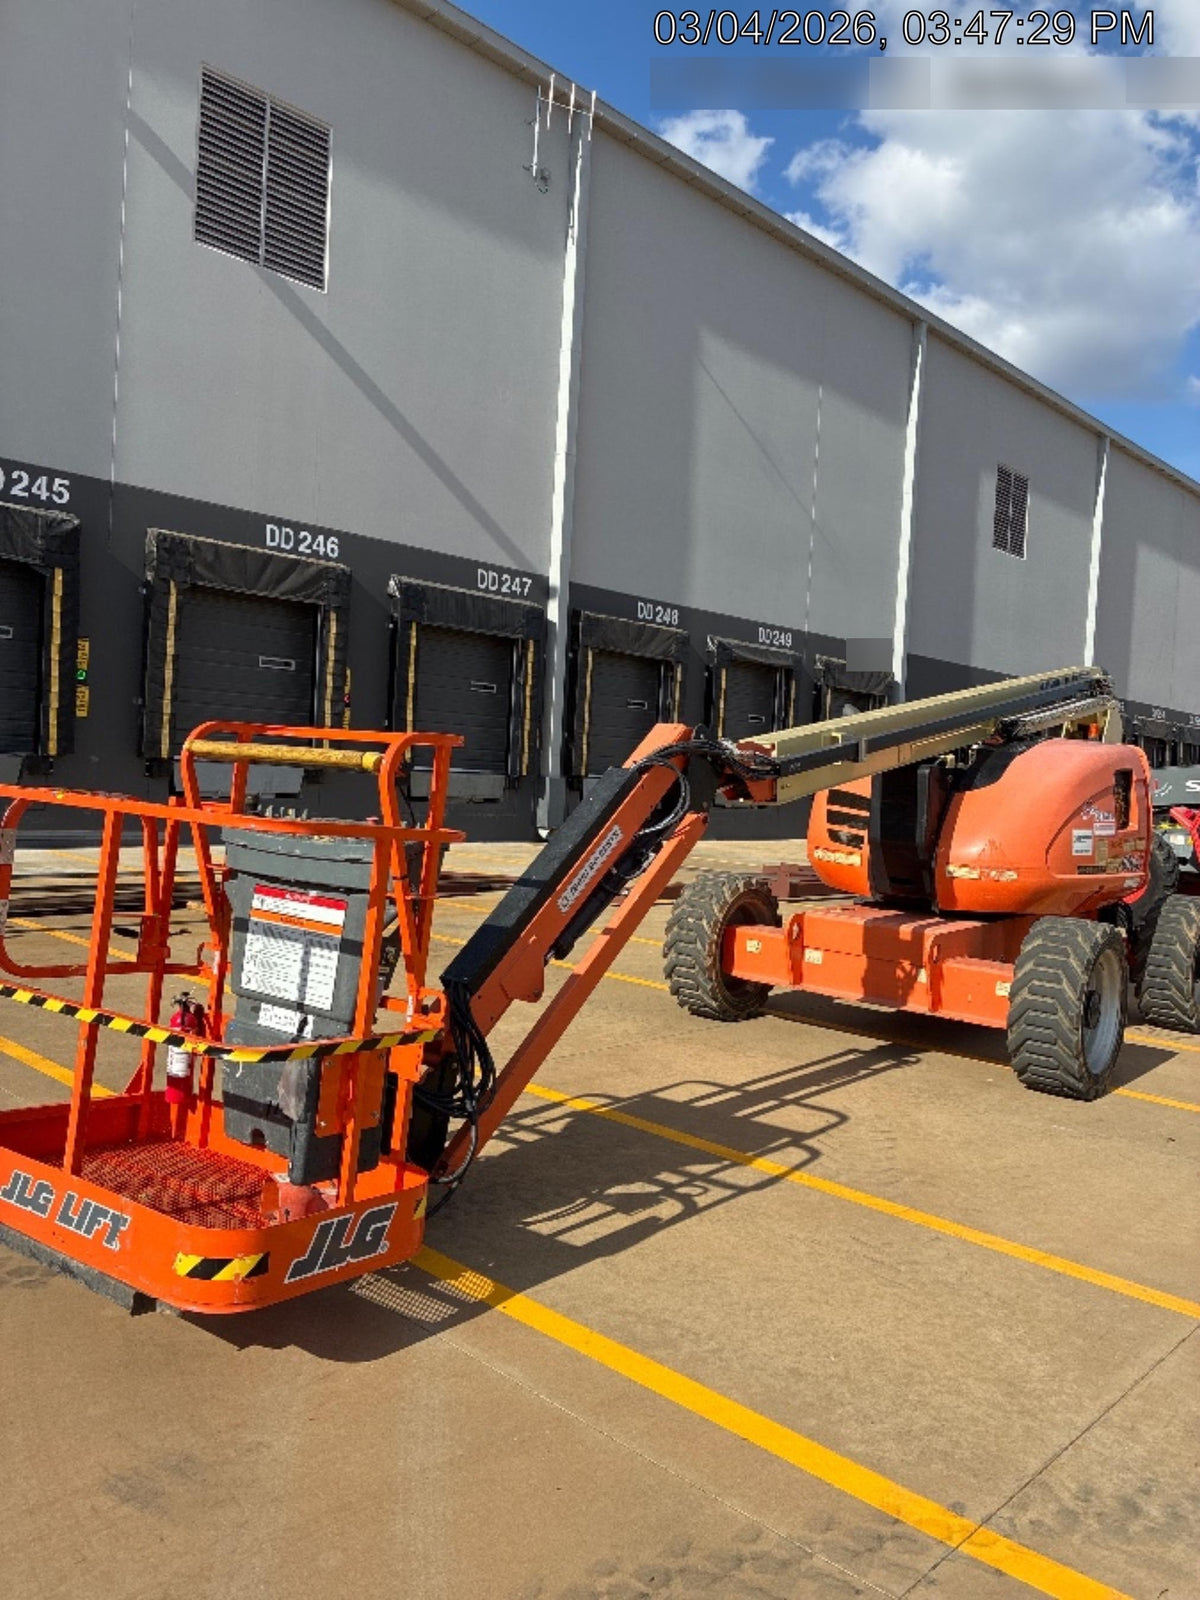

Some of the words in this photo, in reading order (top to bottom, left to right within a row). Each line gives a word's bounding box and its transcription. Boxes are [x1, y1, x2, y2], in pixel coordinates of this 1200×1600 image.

[10, 470, 70, 504] 245
[266, 524, 294, 550] DD
[298, 531, 339, 558] 246
[477, 568, 498, 591] DD
[501, 574, 532, 597] 247
[655, 605, 679, 626] 248
[0, 1169, 56, 1218] JLG
[54, 1190, 132, 1251] LIFT
[284, 1201, 399, 1284] JLG
